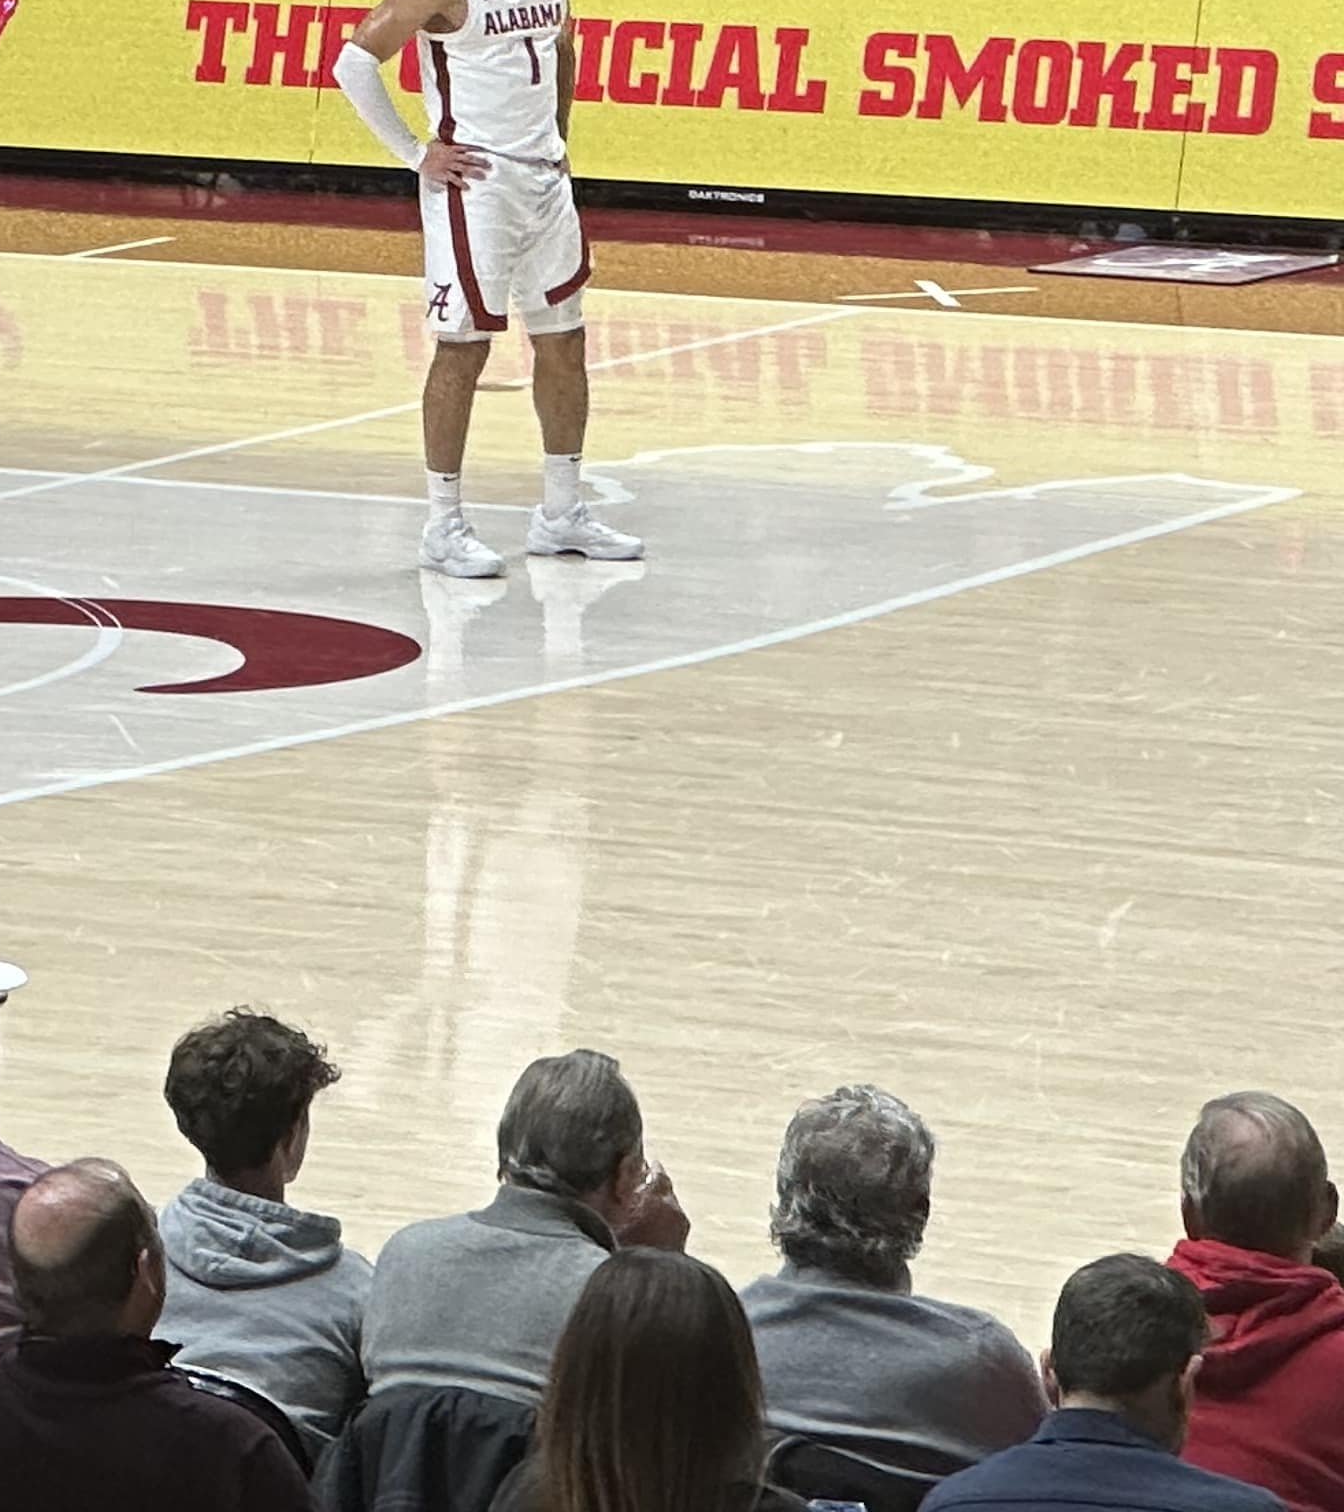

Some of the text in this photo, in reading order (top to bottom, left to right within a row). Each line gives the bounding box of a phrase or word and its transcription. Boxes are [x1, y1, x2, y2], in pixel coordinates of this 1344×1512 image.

[523, 37, 541, 85] 1
[857, 32, 1279, 136] SMOKED
[425, 283, 452, 322] A
